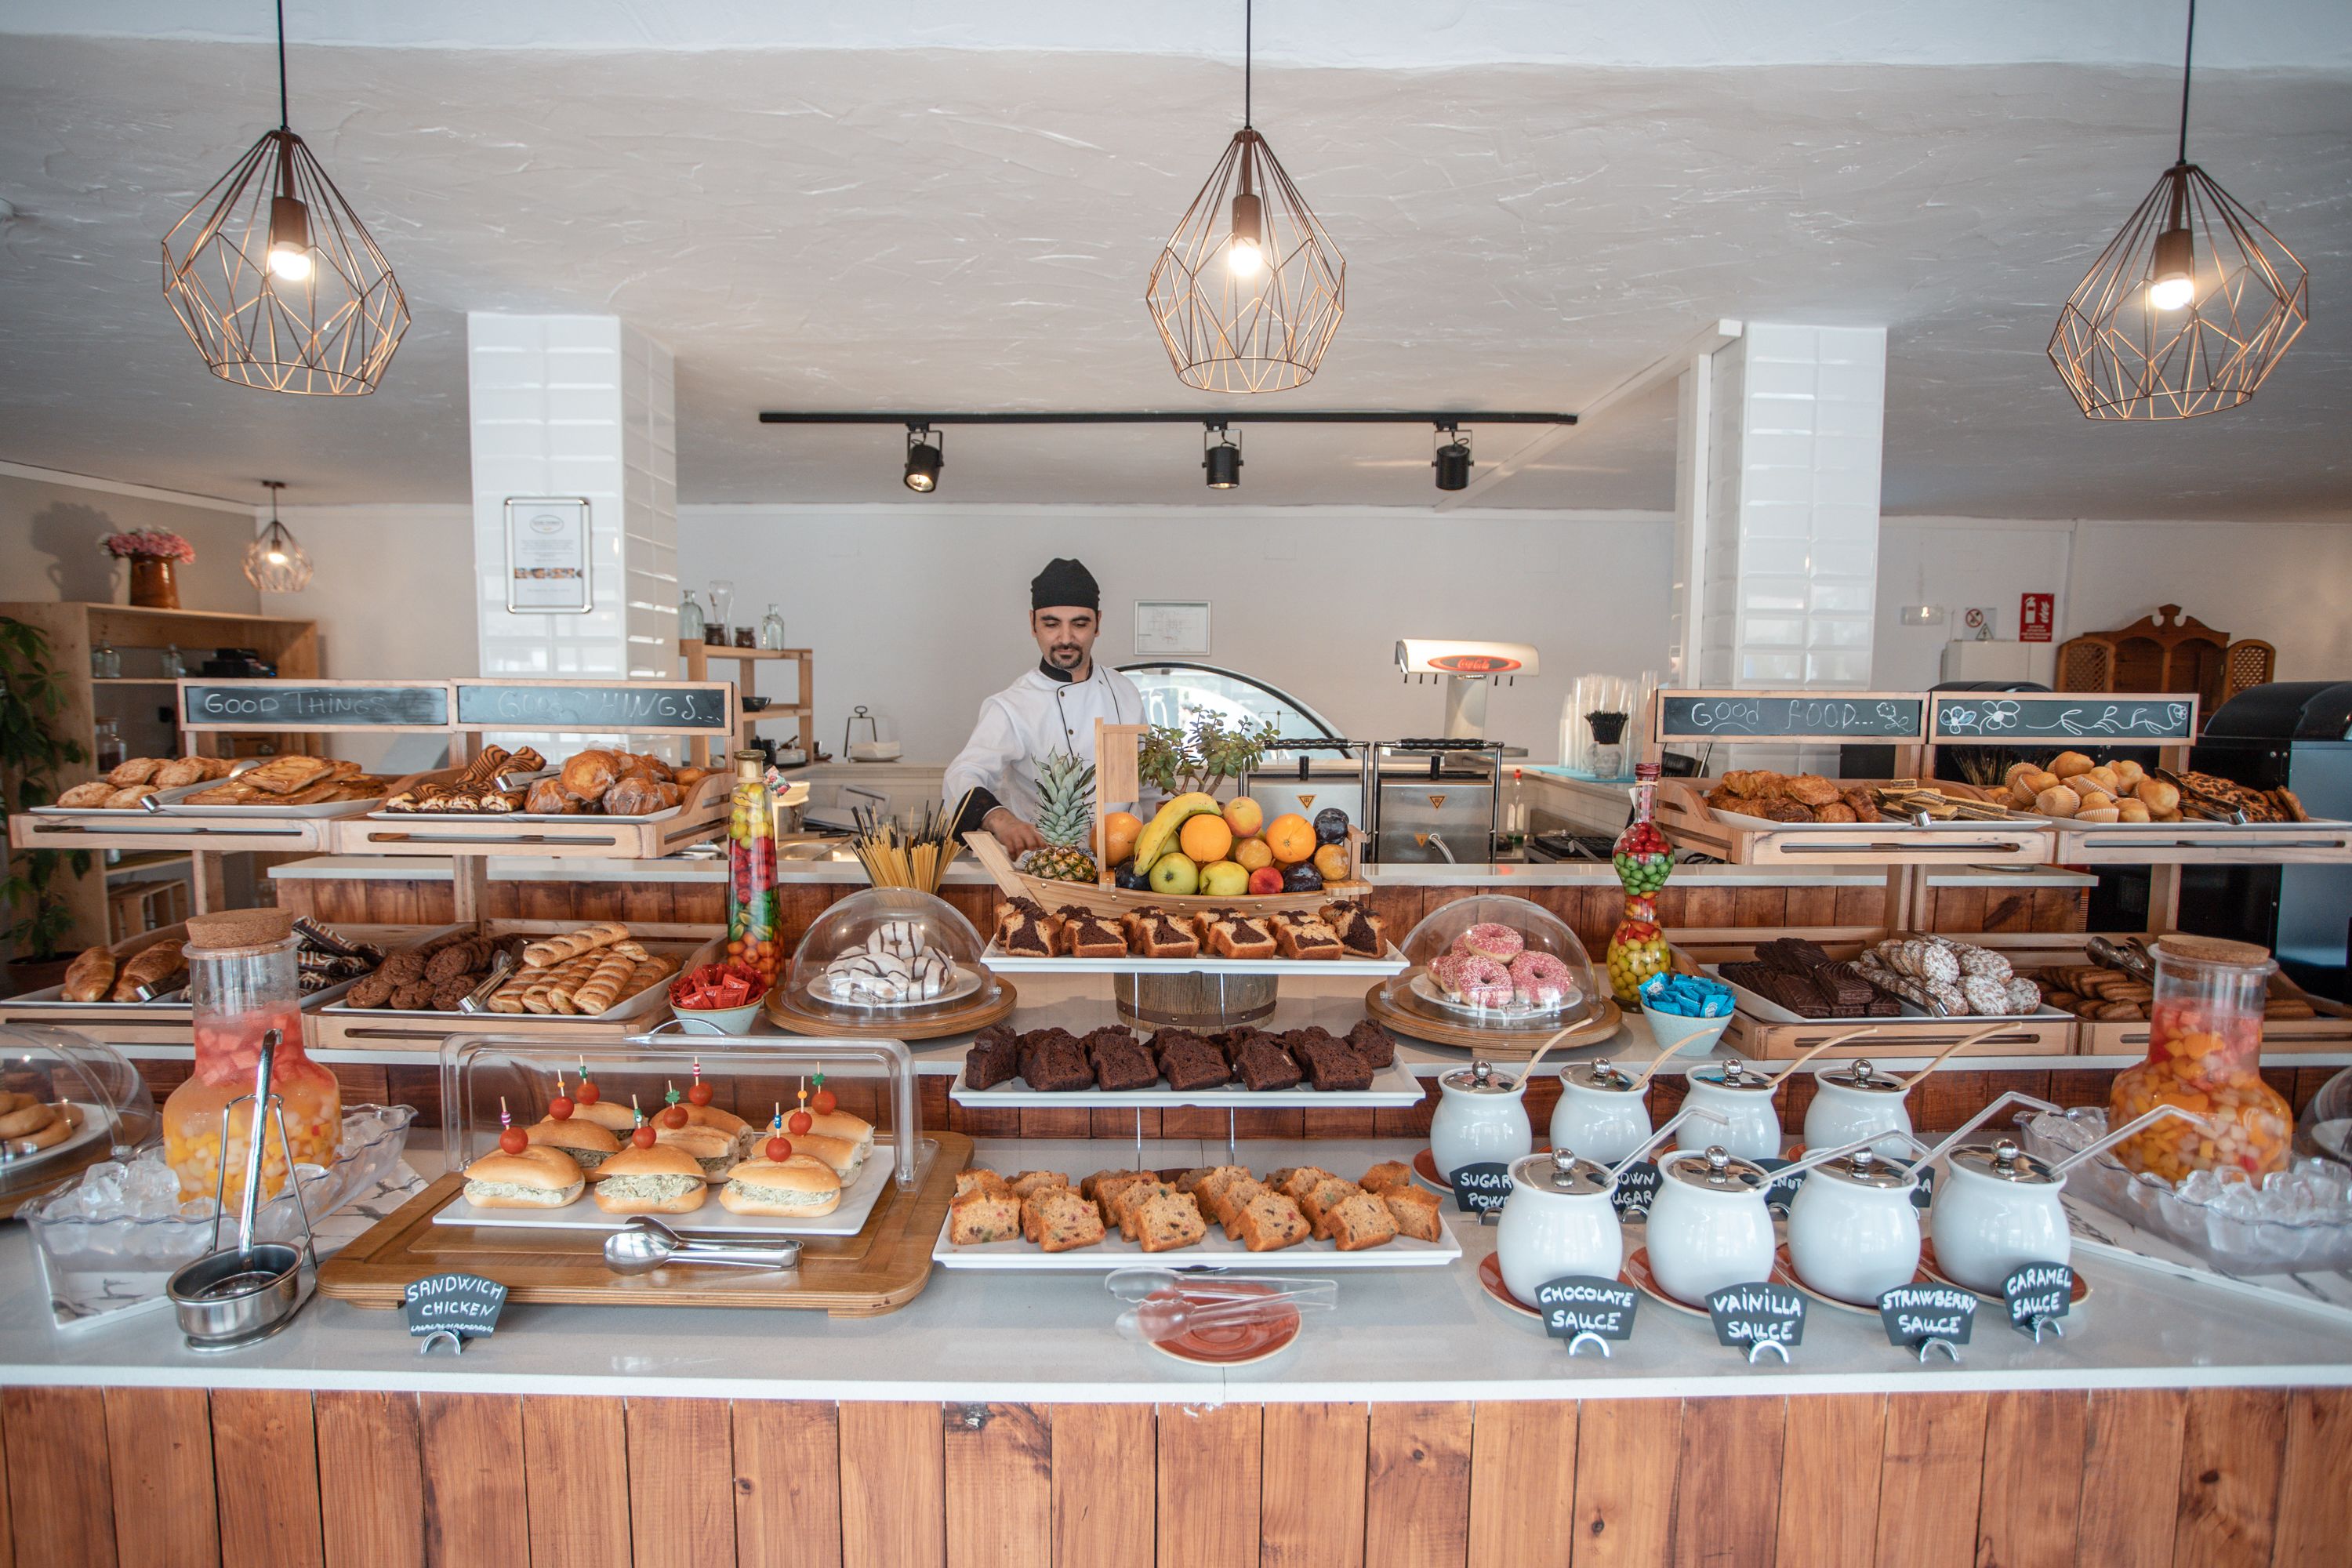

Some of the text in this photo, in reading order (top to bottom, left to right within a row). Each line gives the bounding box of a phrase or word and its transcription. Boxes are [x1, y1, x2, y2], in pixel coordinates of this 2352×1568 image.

[205, 693, 280, 713] GOOD
[1460, 1172, 1512, 1189] SUGAR
[1617, 1171, 1655, 1185] OWN
[1612, 1190, 1653, 1207] UGAR
[407, 1275, 503, 1302] SANDWICH
[2007, 1267, 2072, 1295] CARAMEL
[1540, 1286, 1635, 1308] CHOCOLATE
[1882, 1289, 1977, 1315] STRAWBERRY
[2012, 1291, 2060, 1319] SAUCE
[421, 1301, 495, 1317] CHICKEN
[1551, 1309, 1622, 1331] SAUCE
[1727, 1320, 1796, 1341] SAUCE
[1898, 1314, 1962, 1334] SAUCE
